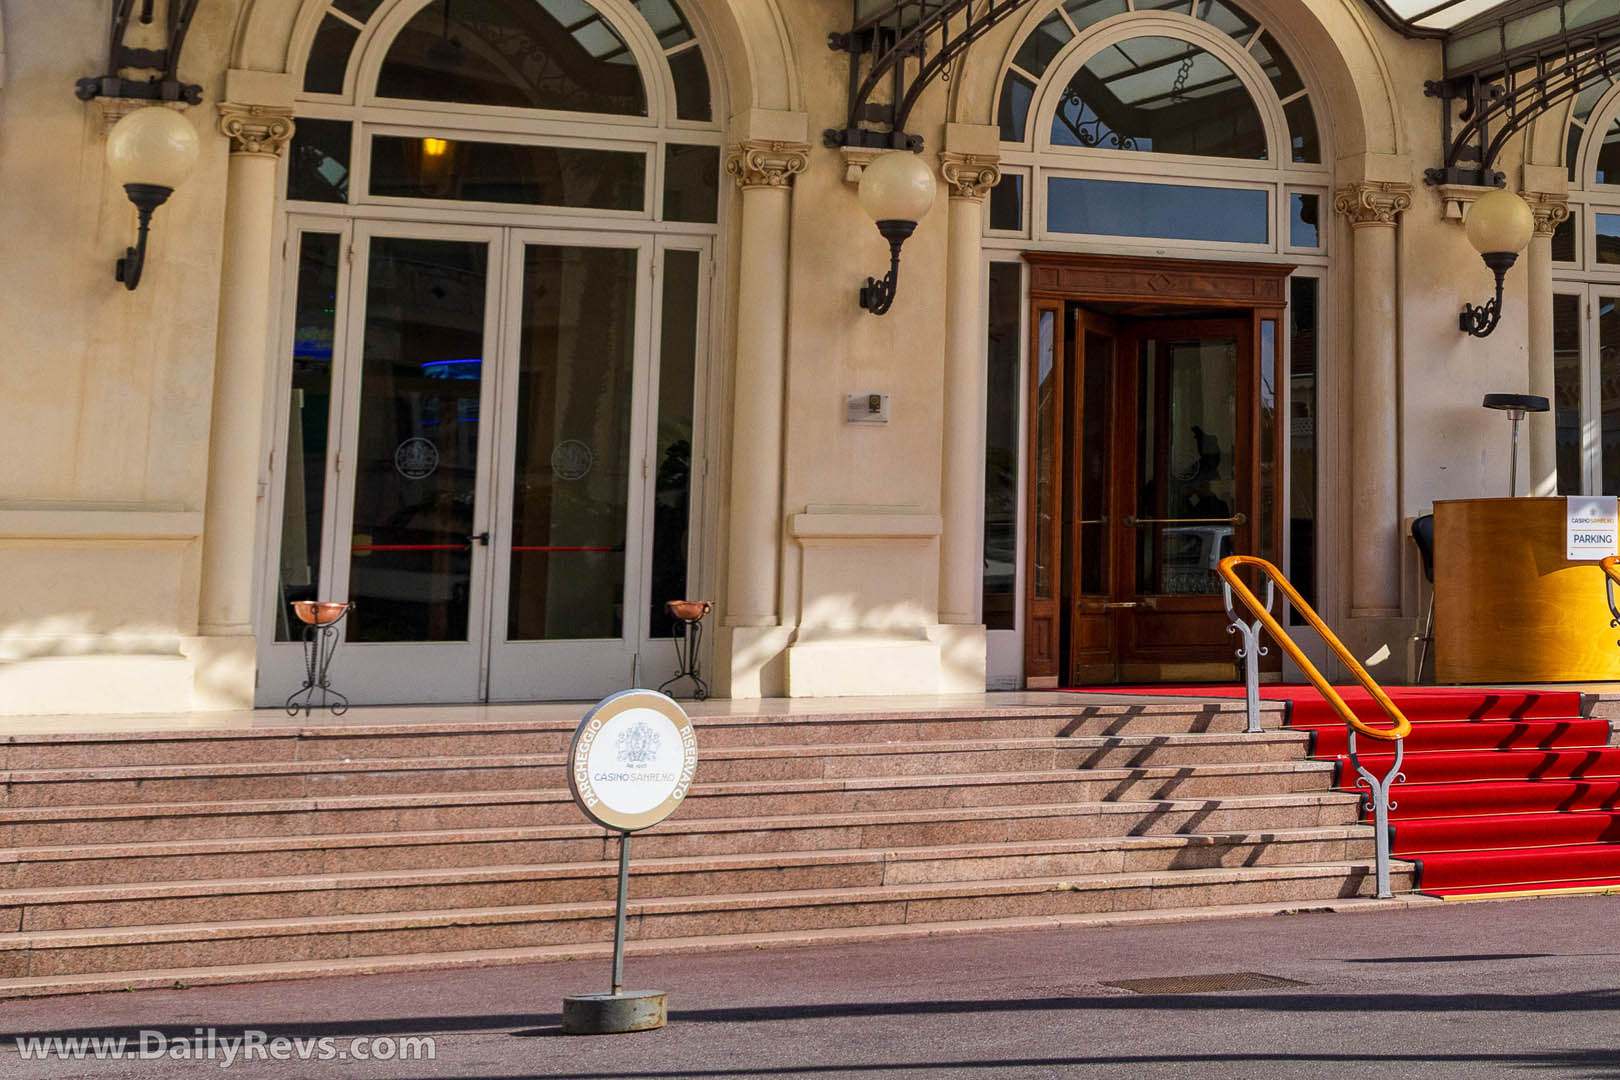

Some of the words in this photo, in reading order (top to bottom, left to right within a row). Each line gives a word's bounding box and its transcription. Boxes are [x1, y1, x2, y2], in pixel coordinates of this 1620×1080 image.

[1573, 534, 1613, 544] PARKING
[575, 719, 602, 808] PARCHEGGIO
[672, 725, 696, 800] RISERVATO
